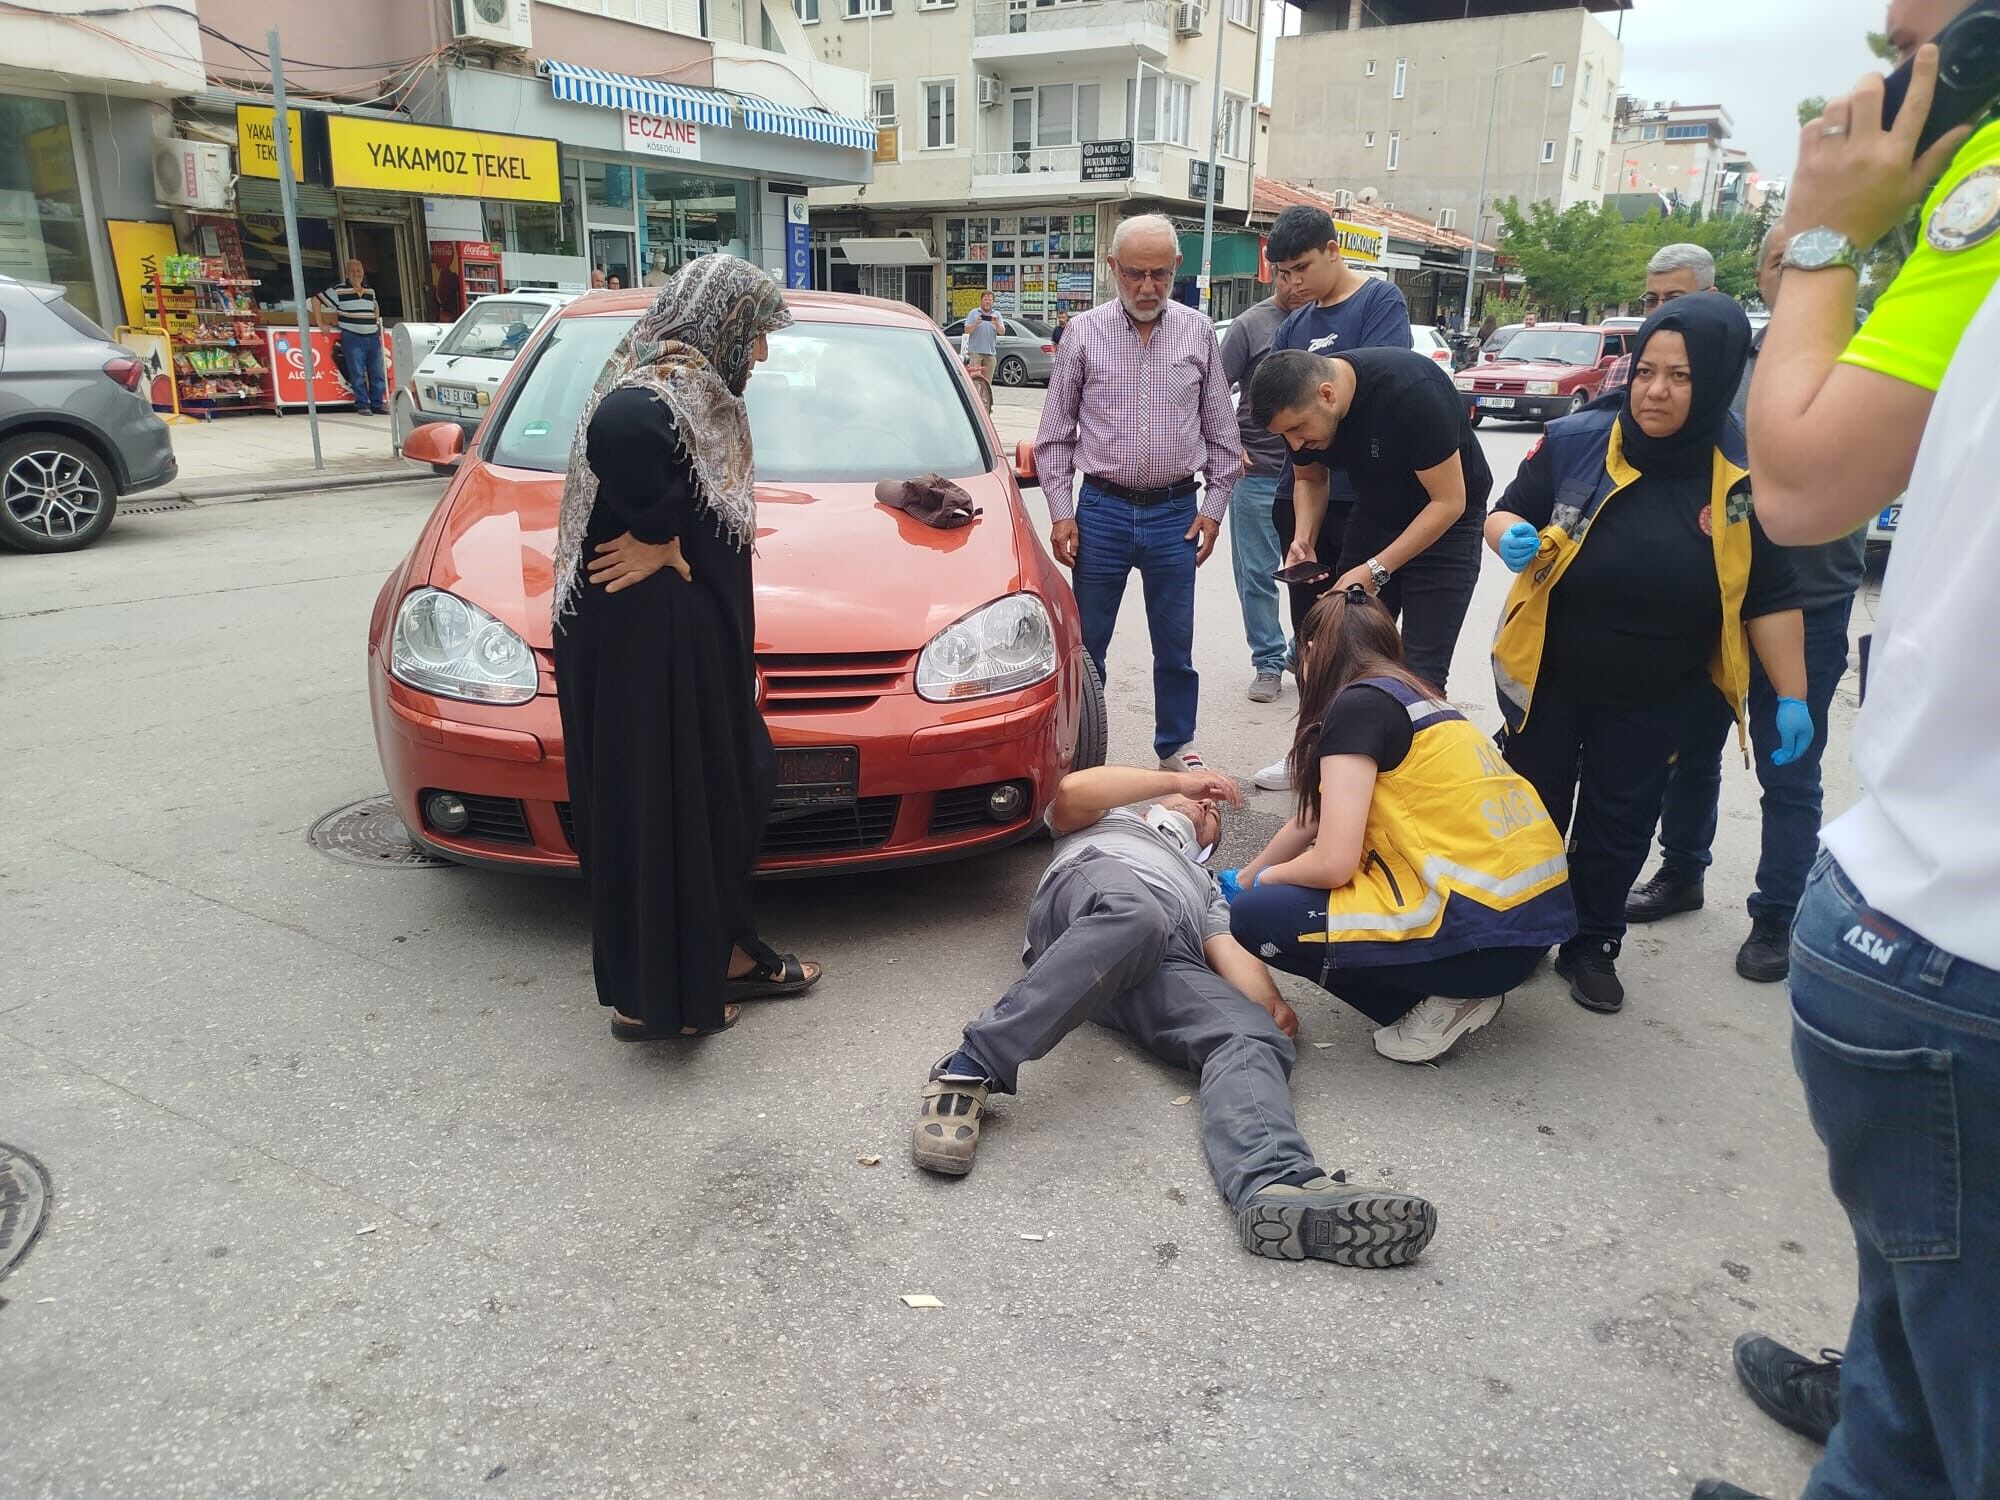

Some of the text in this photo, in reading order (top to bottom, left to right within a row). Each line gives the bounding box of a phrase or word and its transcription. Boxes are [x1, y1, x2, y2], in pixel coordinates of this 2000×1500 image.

[246, 123, 293, 144] YAKAZ
[629, 115, 697, 144] ECZANE
[255, 143, 279, 161] TEK
[647, 142, 680, 154] KÖSEOĞLU
[1094, 145, 1119, 153] KAMER
[367, 142, 531, 180] YAKAMOZ TEKEL
[288, 371, 323, 380] ALGA
[1481, 782, 1547, 837] SAĞL
